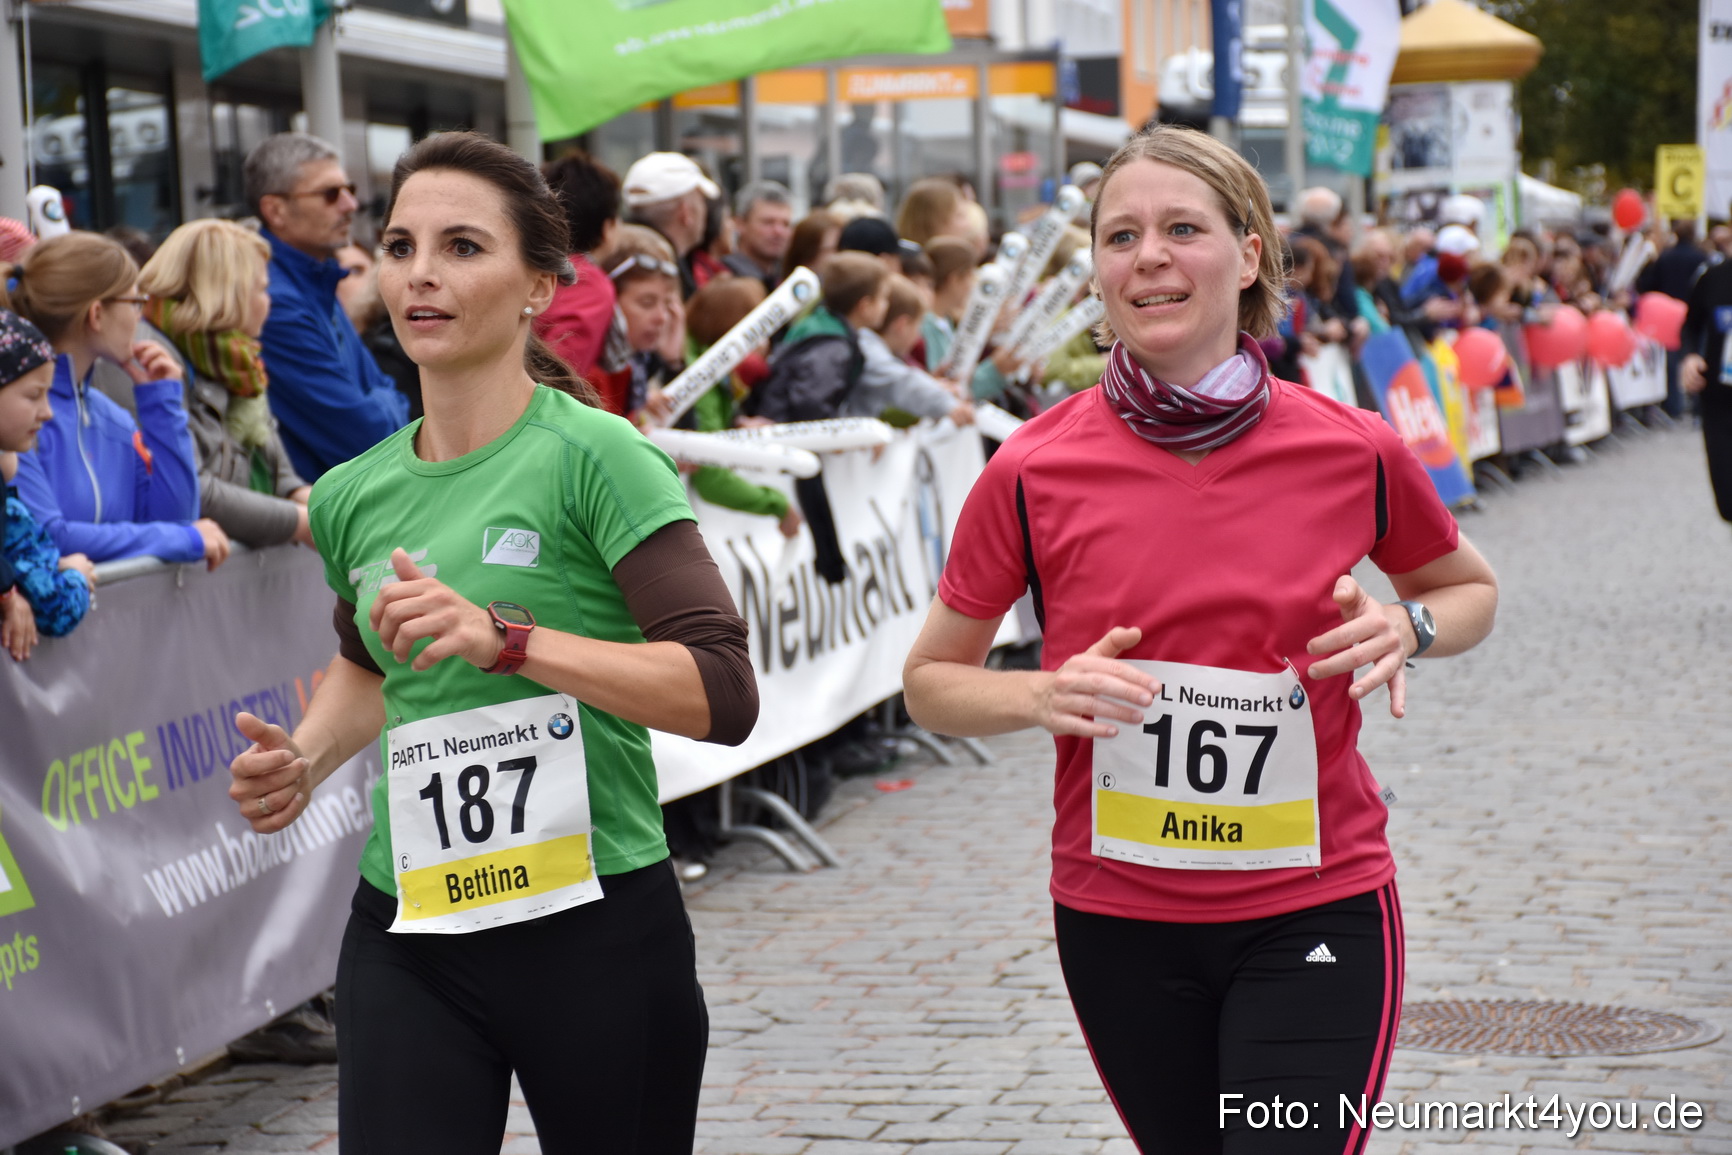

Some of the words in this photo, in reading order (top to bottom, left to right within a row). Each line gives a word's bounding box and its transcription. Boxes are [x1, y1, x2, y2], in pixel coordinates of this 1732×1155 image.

[501, 532, 536, 550] AOK
[1179, 685, 1283, 712] Neumarkt
[391, 742, 440, 771] PARTL
[443, 723, 539, 757] Neumarkt
[1142, 713, 1278, 795] 167
[41, 730, 160, 832] OFFICE
[418, 755, 538, 850] 187
[1160, 811, 1243, 843] Anika
[445, 863, 530, 904] Bettina
[0, 931, 40, 991] pts
[1305, 954, 1337, 963] adidas
